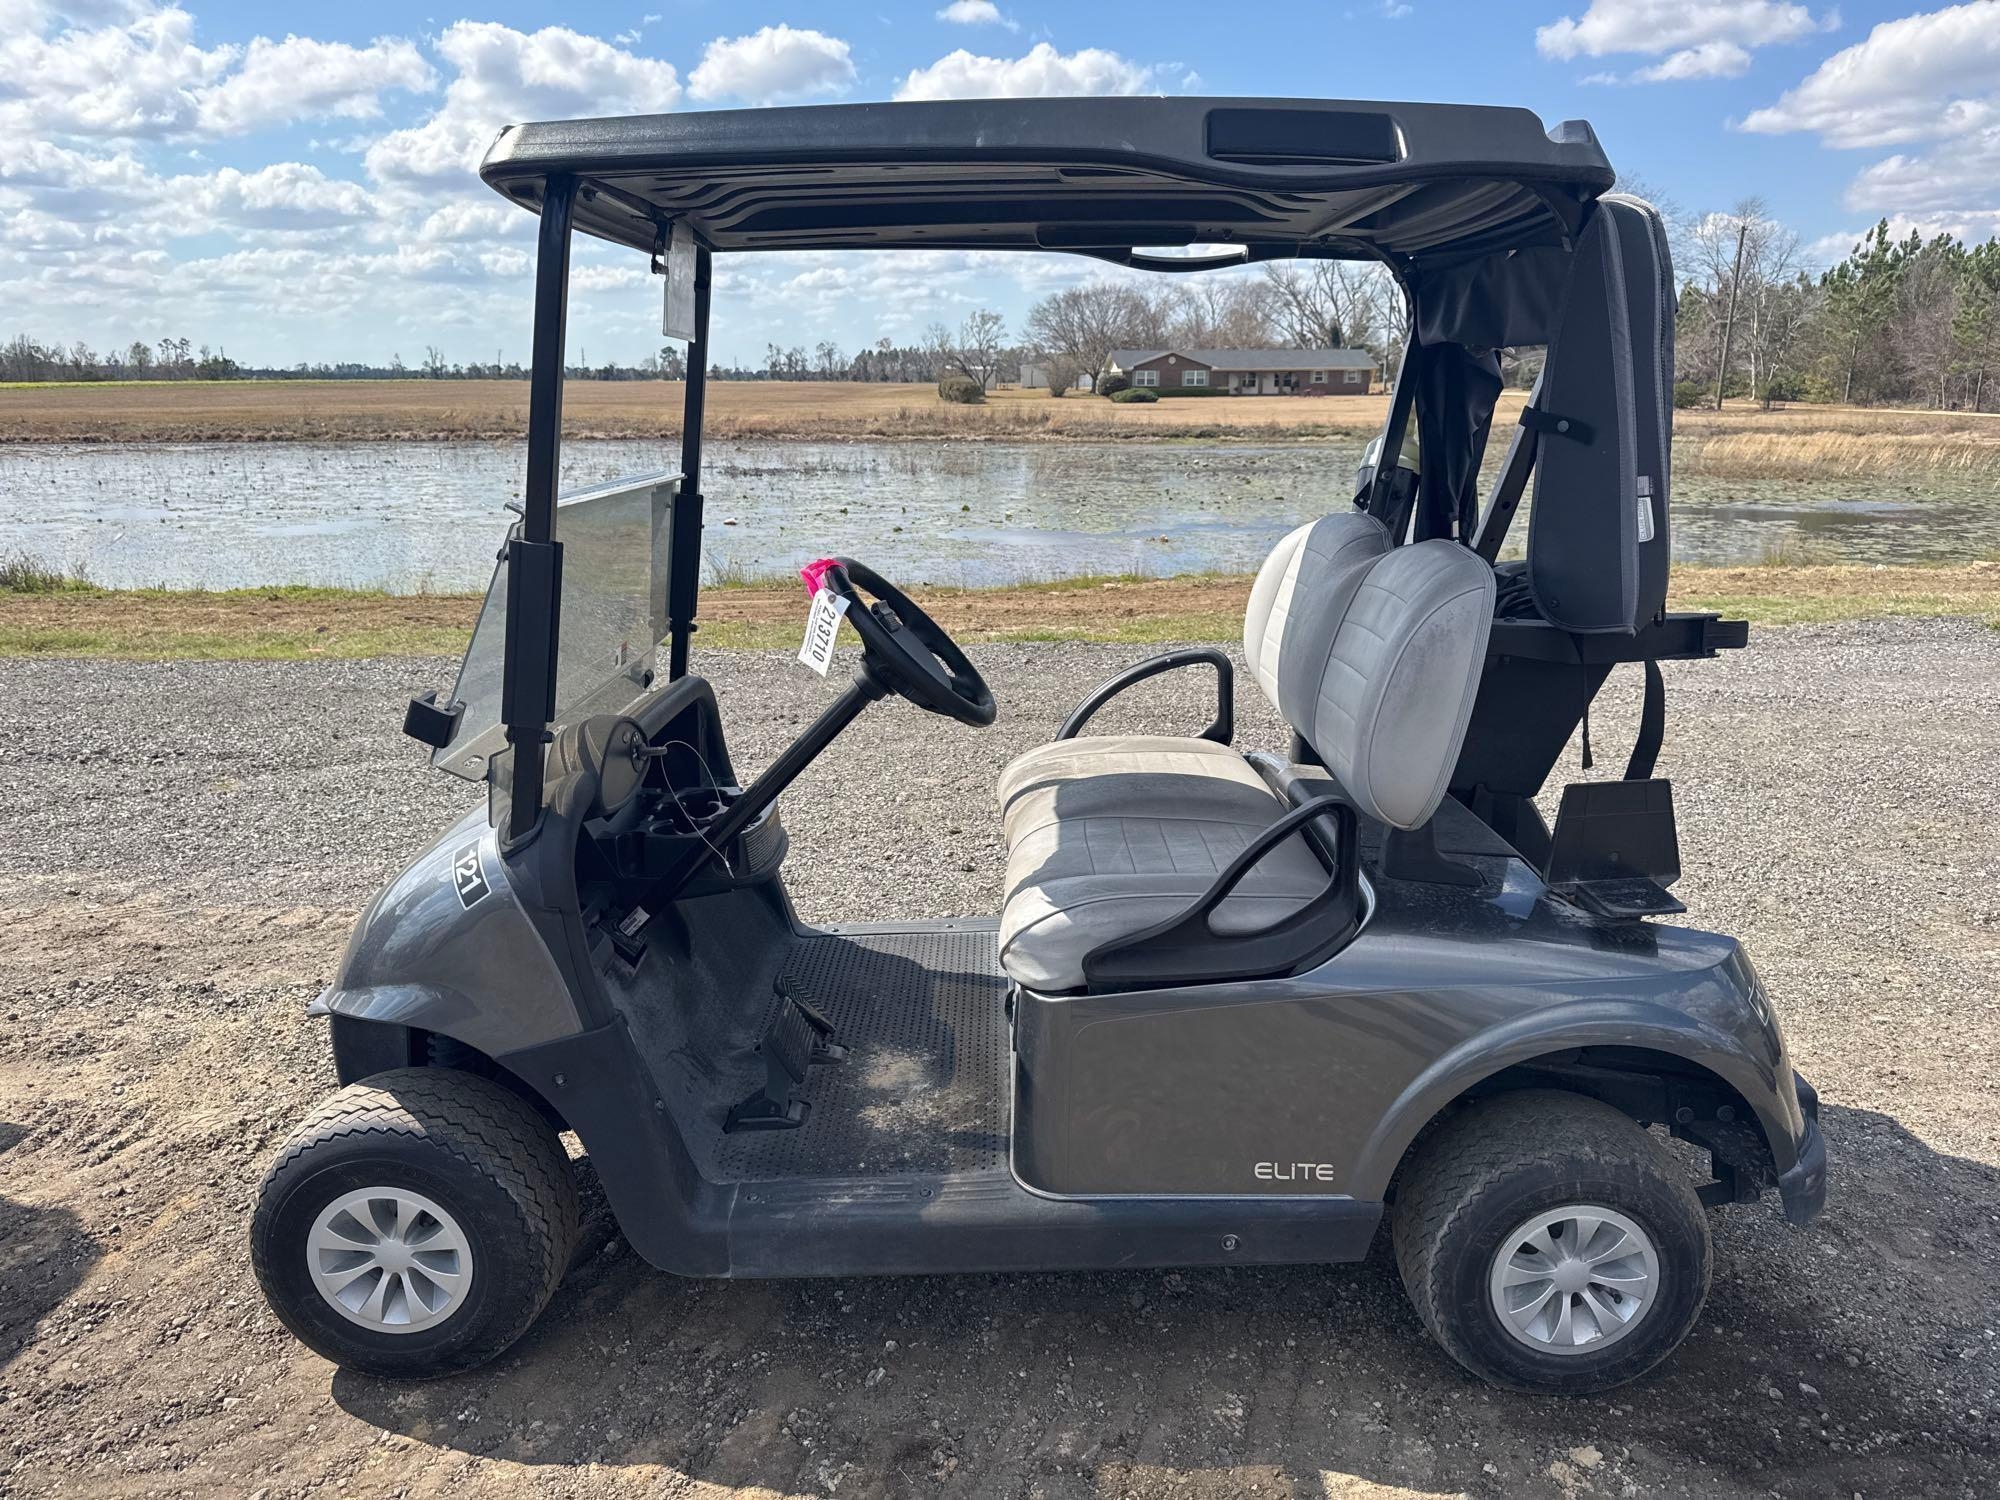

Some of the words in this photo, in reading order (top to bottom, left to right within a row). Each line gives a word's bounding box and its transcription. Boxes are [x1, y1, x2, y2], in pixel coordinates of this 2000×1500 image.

[812, 603, 836, 663] 213710
[455, 849, 482, 895] 121
[1254, 1162, 1334, 1181] ELITE
